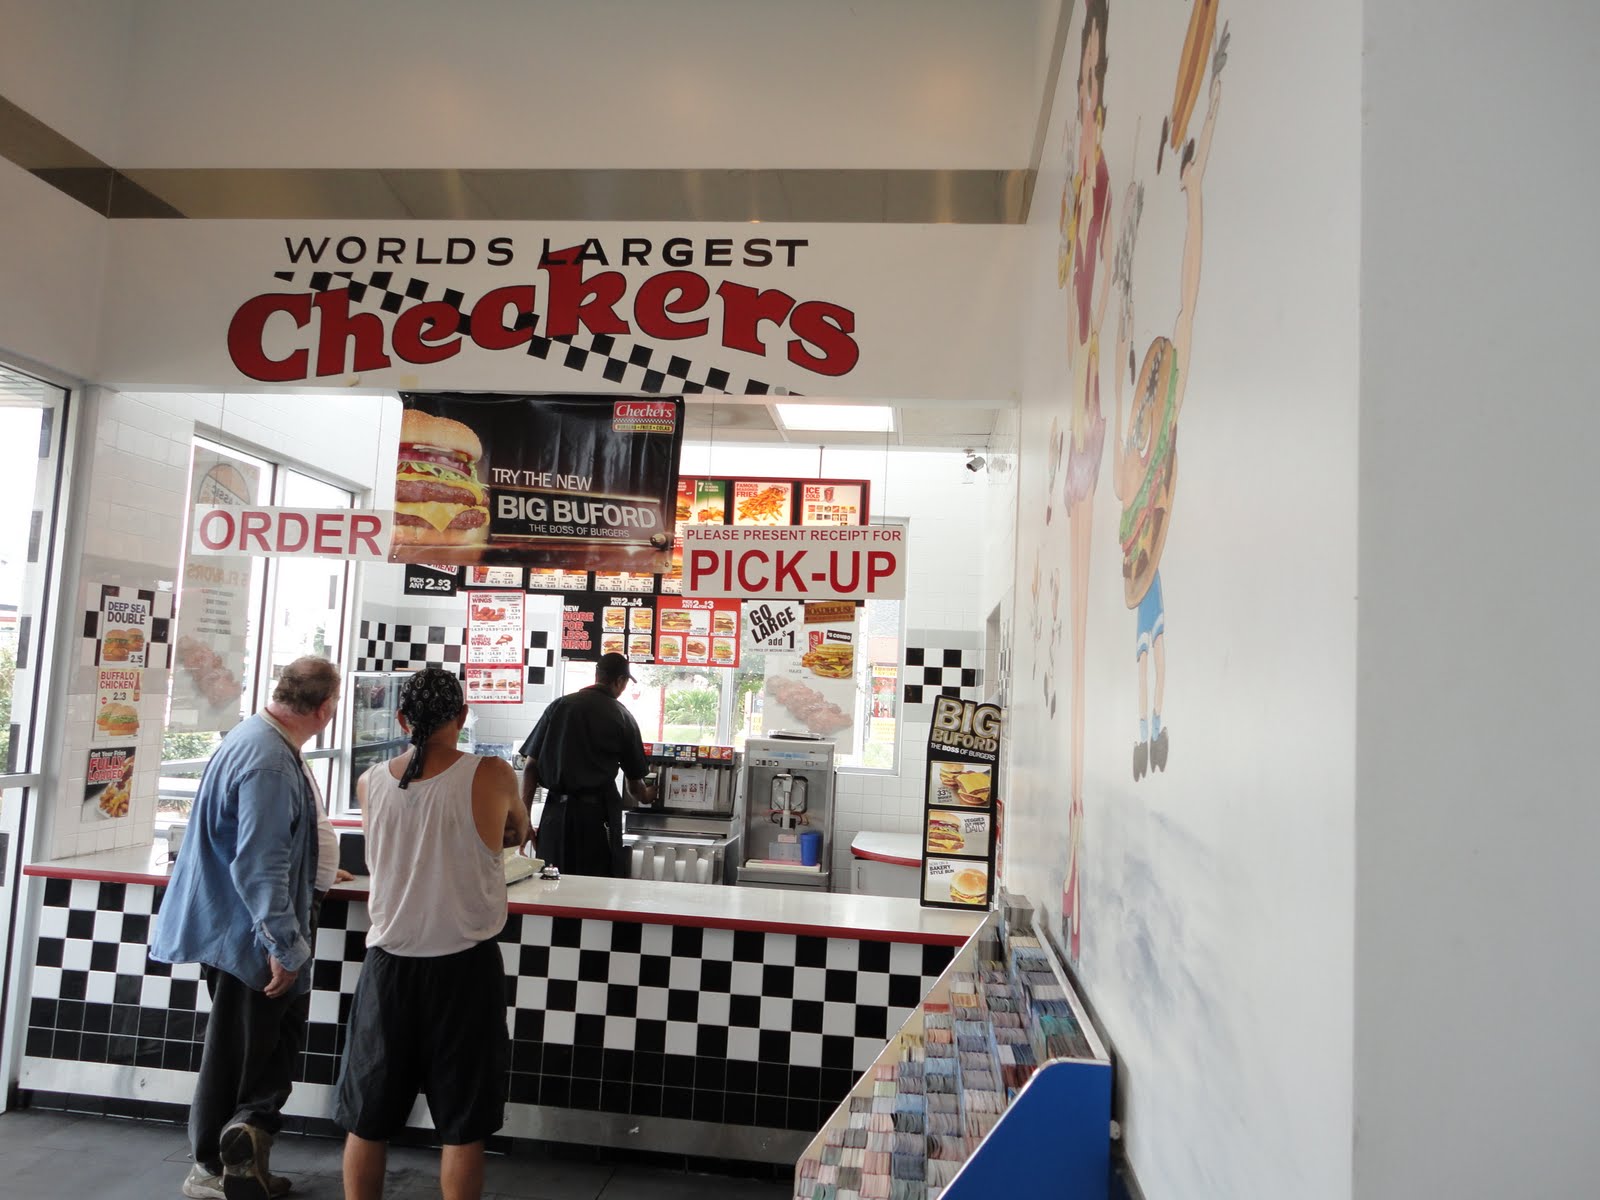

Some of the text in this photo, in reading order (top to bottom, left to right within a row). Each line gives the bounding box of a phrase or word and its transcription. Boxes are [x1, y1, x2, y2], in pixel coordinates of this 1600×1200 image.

[285, 237, 808, 269] WORLDS LARGEST
[227, 244, 860, 382] Checkers
[616, 404, 672, 418] Checkers
[492, 468, 592, 491] TRY THE NEW
[498, 495, 656, 528] BIG BUFORD
[200, 510, 382, 556] ORDER
[529, 523, 630, 538] THE BOSS OF BURGERS
[687, 530, 901, 541] PLEASE PRESENT RECEIPT FOR
[690, 549, 896, 593] PICK-UP
[425, 578, 434, 590] 2
[108, 601, 146, 614] DEEP SEA
[622, 598, 628, 606] 2
[693, 600, 699, 608] 2
[107, 612, 146, 625] DOUBLE
[563, 612, 594, 622] MORE
[749, 604, 772, 626] GO
[563, 621, 584, 631] FOR
[751, 606, 796, 644] LARGE
[562, 631, 589, 640] LESS
[768, 630, 794, 649] add $1
[562, 640, 592, 650] MENU
[100, 671, 135, 680] BUFFALO
[100, 680, 134, 689] CHICKEN
[934, 698, 1001, 740] BIG
[931, 728, 998, 752] BUFORD
[930, 742, 941, 751] THE
[942, 745, 960, 754] BOSS
[969, 750, 996, 761] BURGERS
[89, 756, 126, 771] FULLY
[88, 769, 124, 781] LOADED
[966, 824, 986, 833] DAILY
